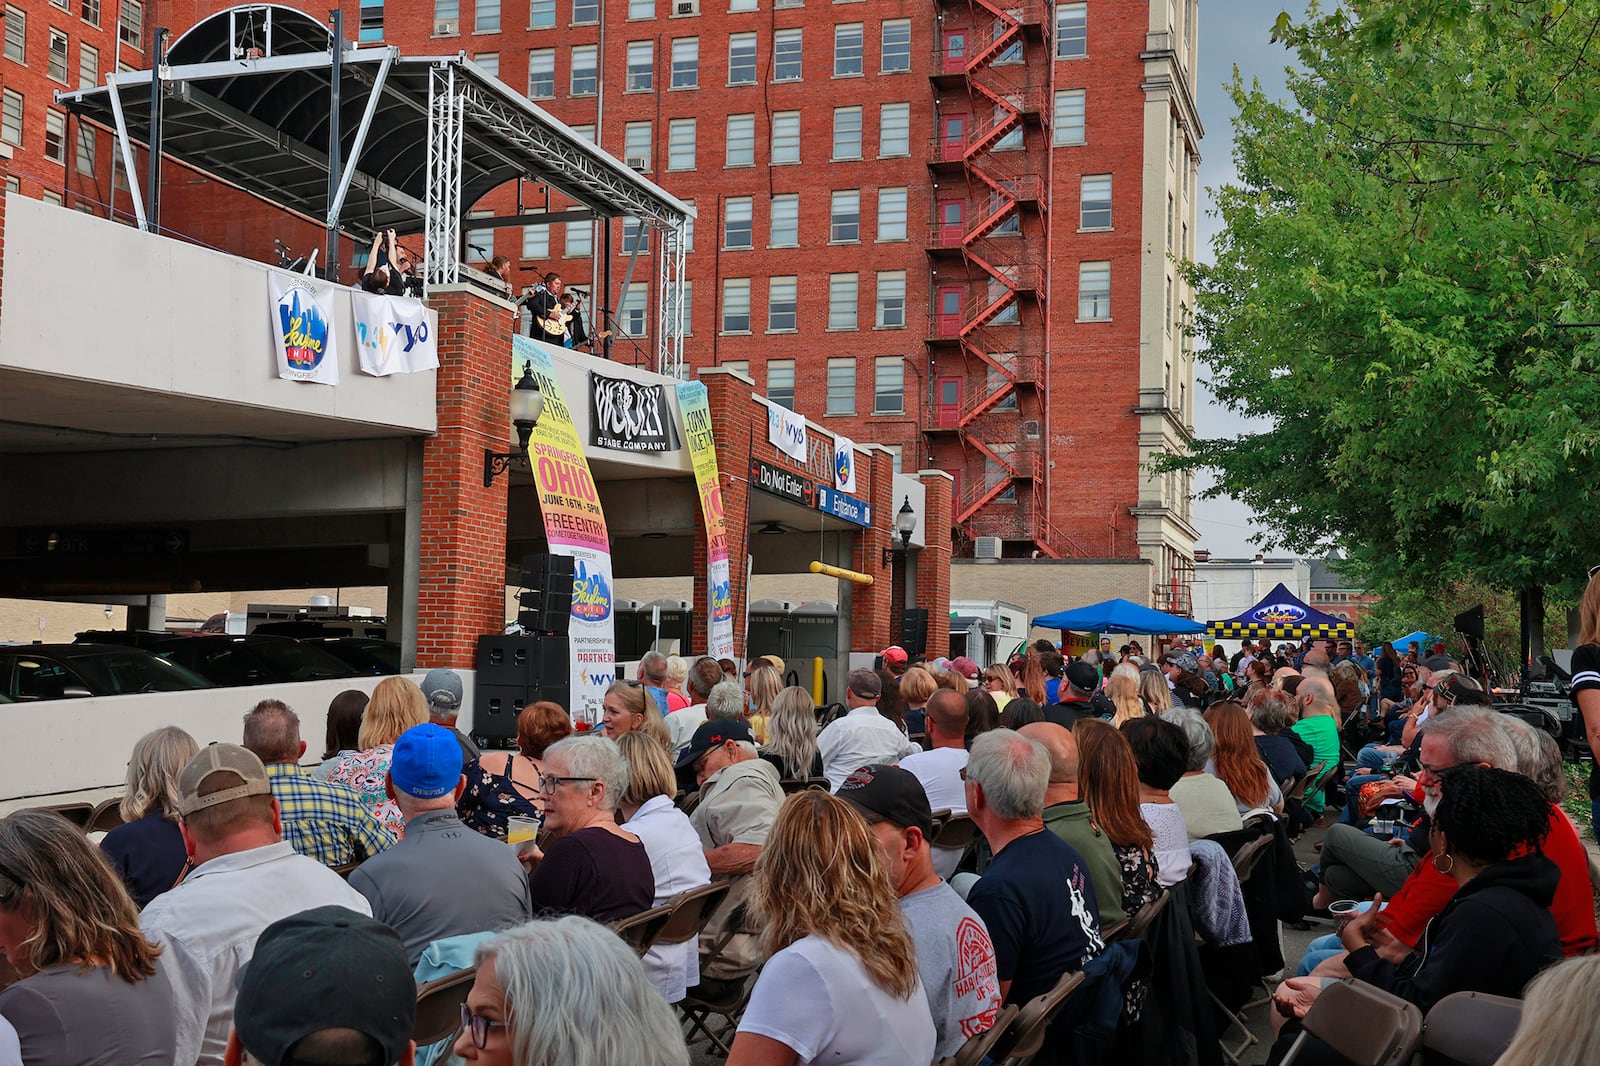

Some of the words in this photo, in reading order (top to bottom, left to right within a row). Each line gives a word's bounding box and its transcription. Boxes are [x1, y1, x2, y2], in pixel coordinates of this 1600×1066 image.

[534, 442, 586, 469] SPRINGFIELD
[597, 436, 622, 449] STAGE
[623, 440, 666, 451] COMPANY
[538, 457, 596, 502] OHIO
[760, 465, 772, 486] Do
[772, 470, 786, 491] Not
[786, 477, 803, 498] Enter
[543, 493, 564, 506] JUNE
[565, 497, 583, 511] 16TH
[587, 504, 601, 516] 5PM
[833, 494, 859, 520] Entrance
[545, 512, 575, 531] FREE
[575, 517, 604, 537] ENTRY
[571, 580, 610, 609] Skyline
[412, 786, 445, 795] SPRINGFIELD
